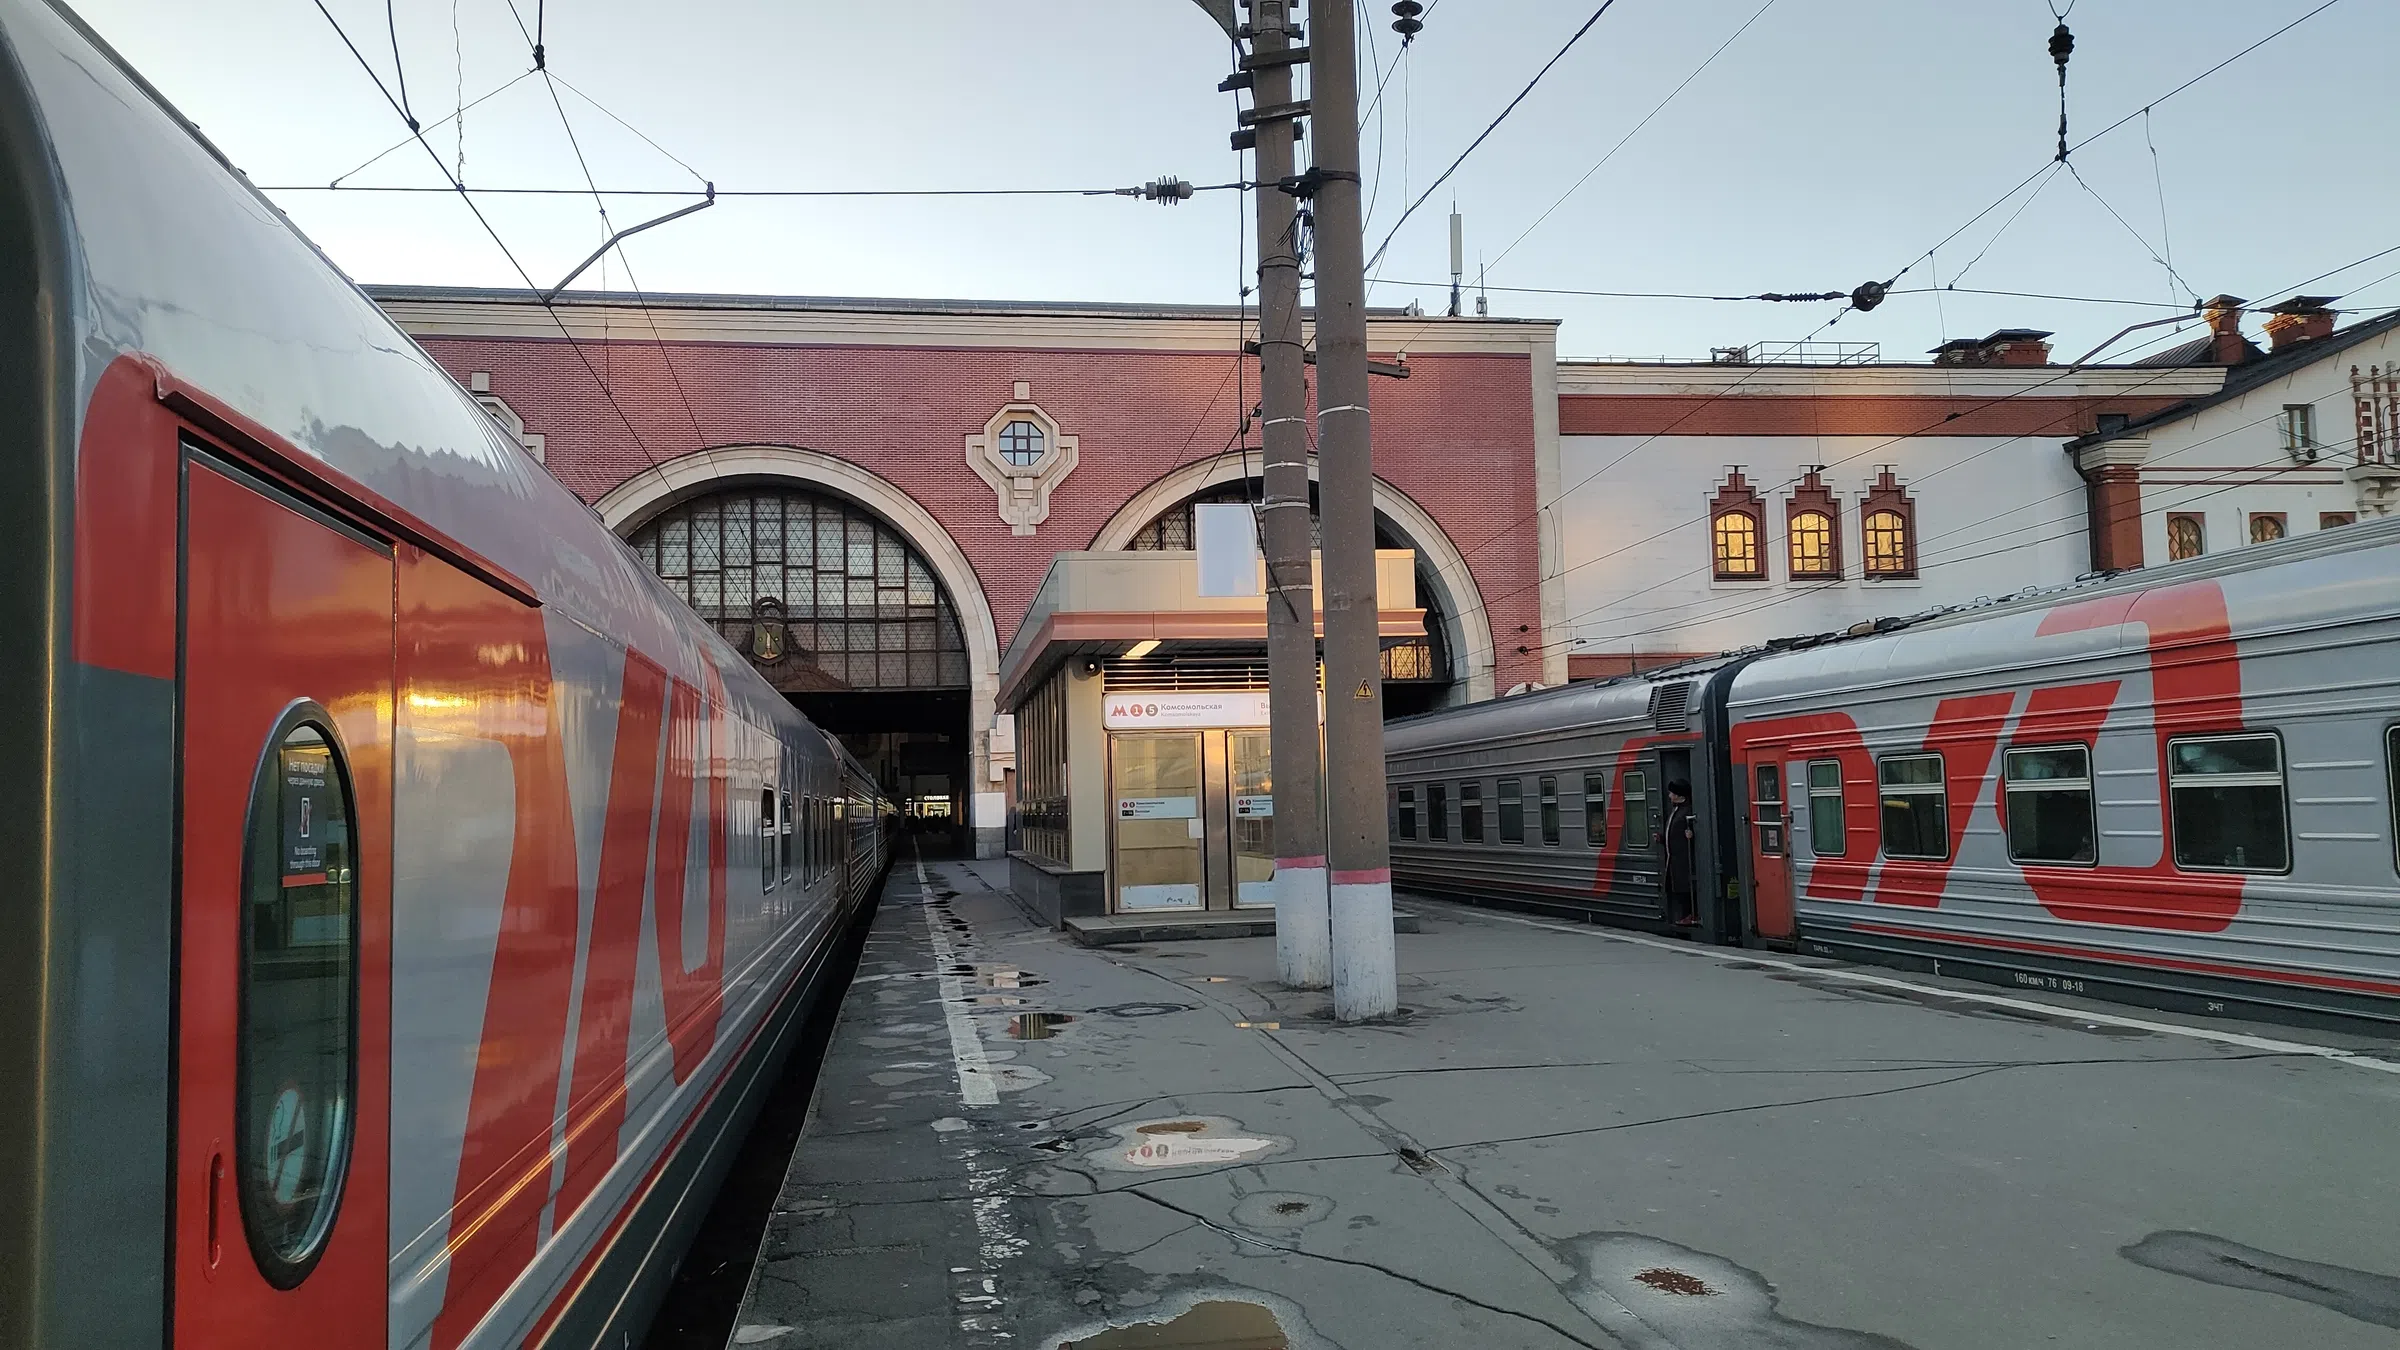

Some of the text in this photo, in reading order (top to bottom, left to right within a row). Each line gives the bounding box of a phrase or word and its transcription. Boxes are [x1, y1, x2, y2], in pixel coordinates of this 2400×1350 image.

[1160, 703, 1223, 712] Комсомольская
[288, 757, 325, 776] Нет посадки
[2047, 977, 2057, 989] 76
[2062, 979, 2084, 993] 09-18
